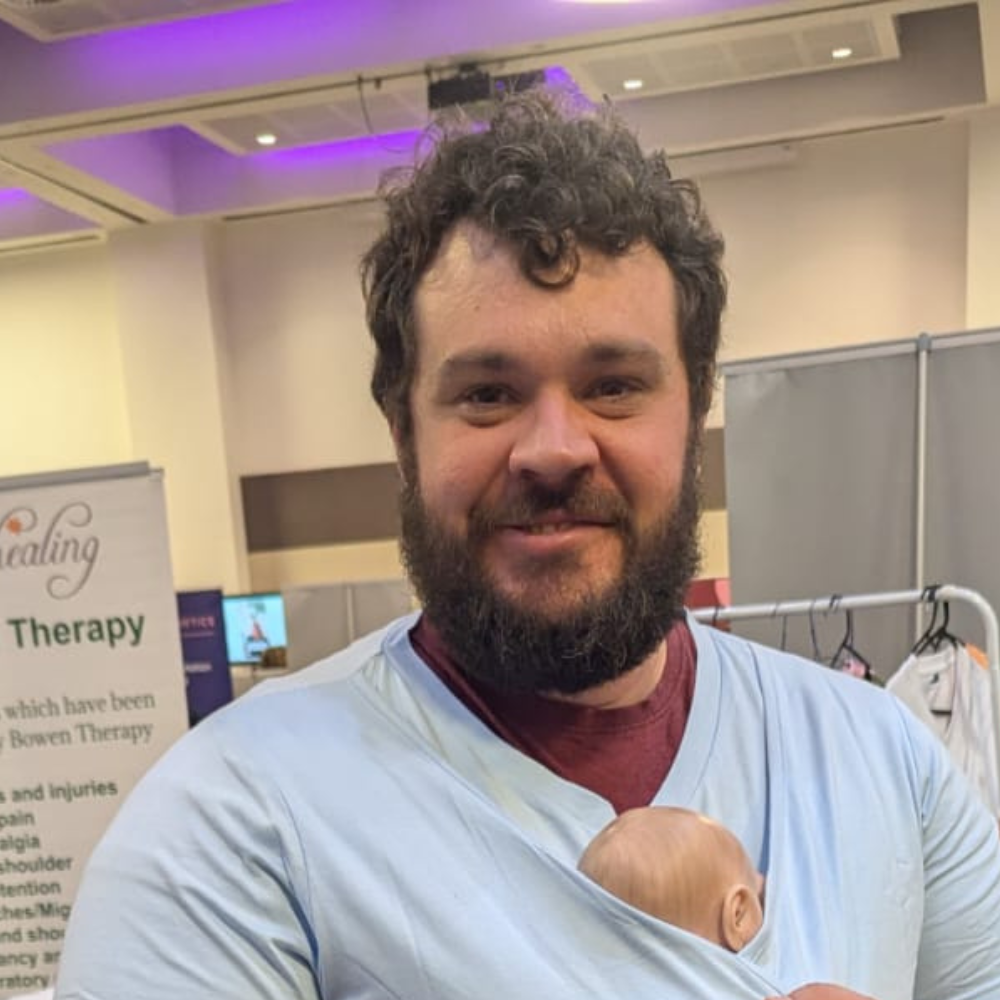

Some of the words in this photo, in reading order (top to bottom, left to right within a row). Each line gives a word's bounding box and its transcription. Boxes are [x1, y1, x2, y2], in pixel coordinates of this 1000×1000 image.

[7, 614, 145, 648] Therapy
[3, 699, 60, 719] which
[63, 695, 107, 715] have
[109, 690, 156, 711] been
[9, 729, 72, 749] Bowen
[75, 722, 154, 746] Therapy
[12, 783, 44, 802] and
[49, 780, 118, 802] injuries
